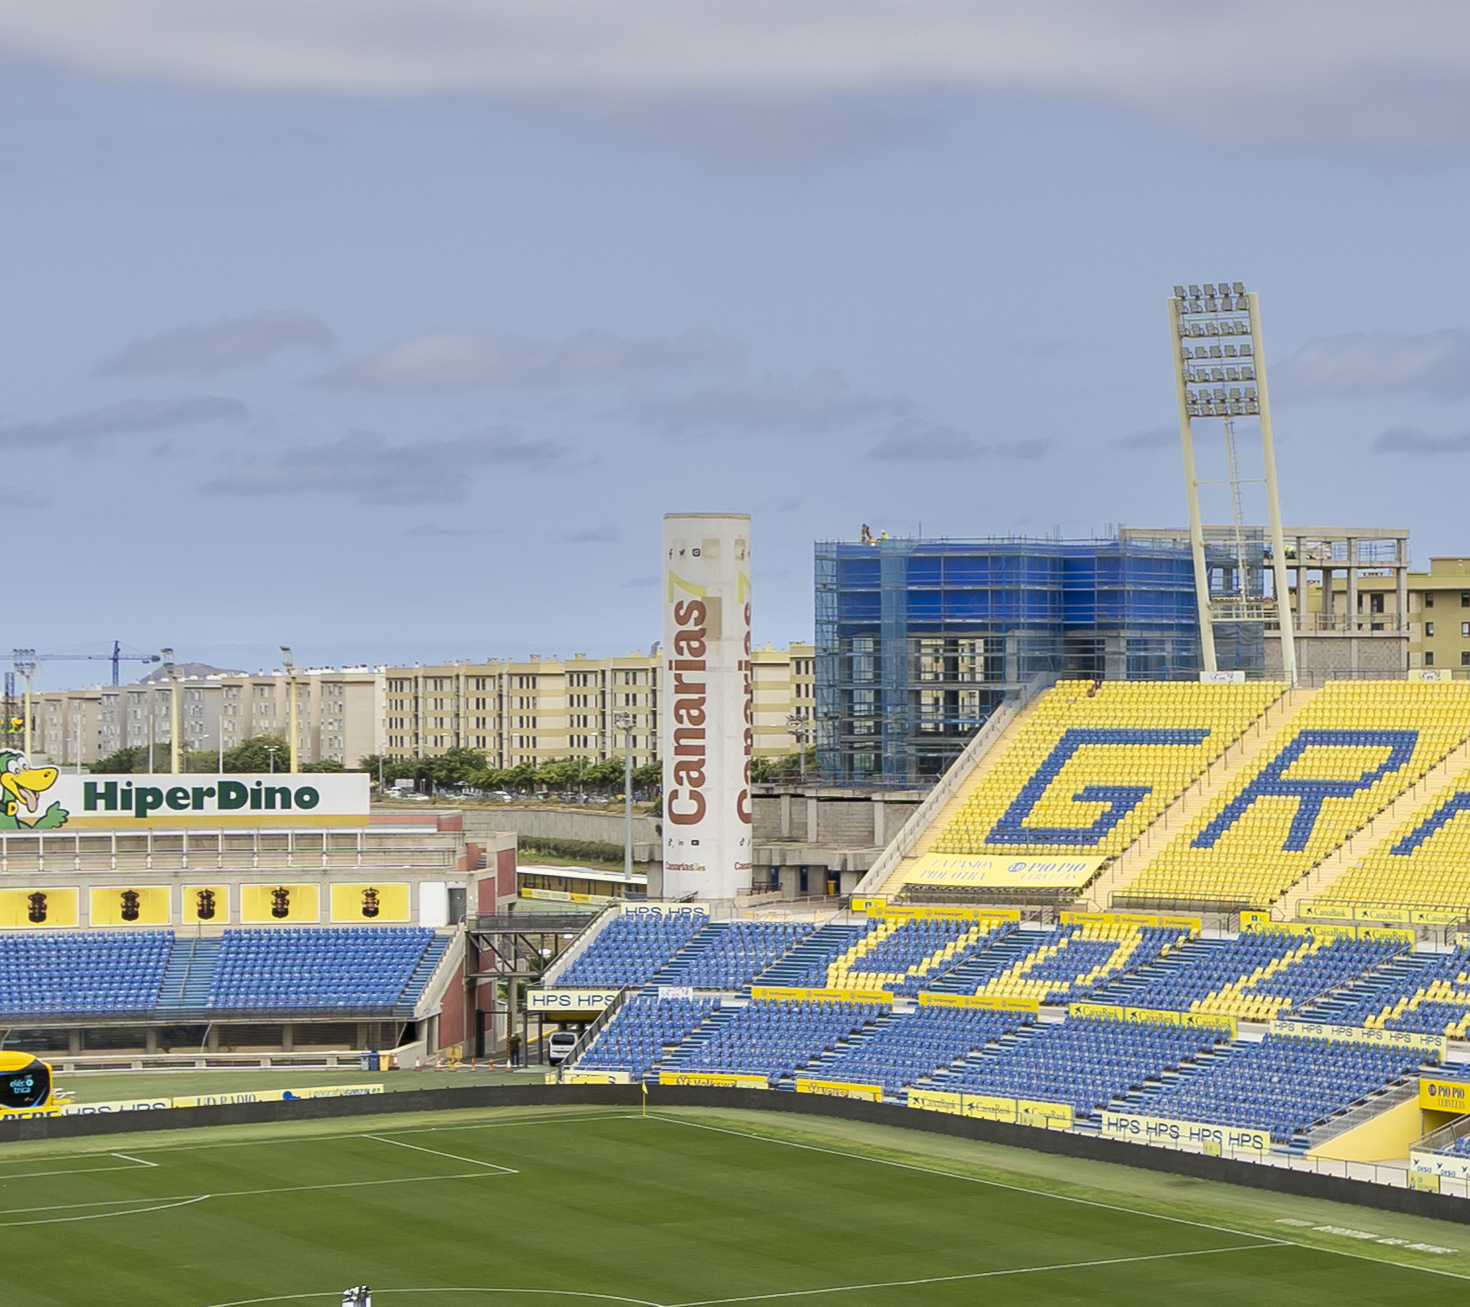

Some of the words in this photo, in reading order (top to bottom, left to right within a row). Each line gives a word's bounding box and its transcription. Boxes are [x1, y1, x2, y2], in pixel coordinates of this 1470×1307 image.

[668, 567, 706, 825] Canarias7
[84, 781, 319, 818] HiperDino
[533, 995, 571, 1006] HPS
[1107, 1116, 1141, 1135] HPS
[1146, 1121, 1180, 1140] HPS
[1189, 1126, 1223, 1145] HPS
[1229, 1131, 1263, 1150] HPS
